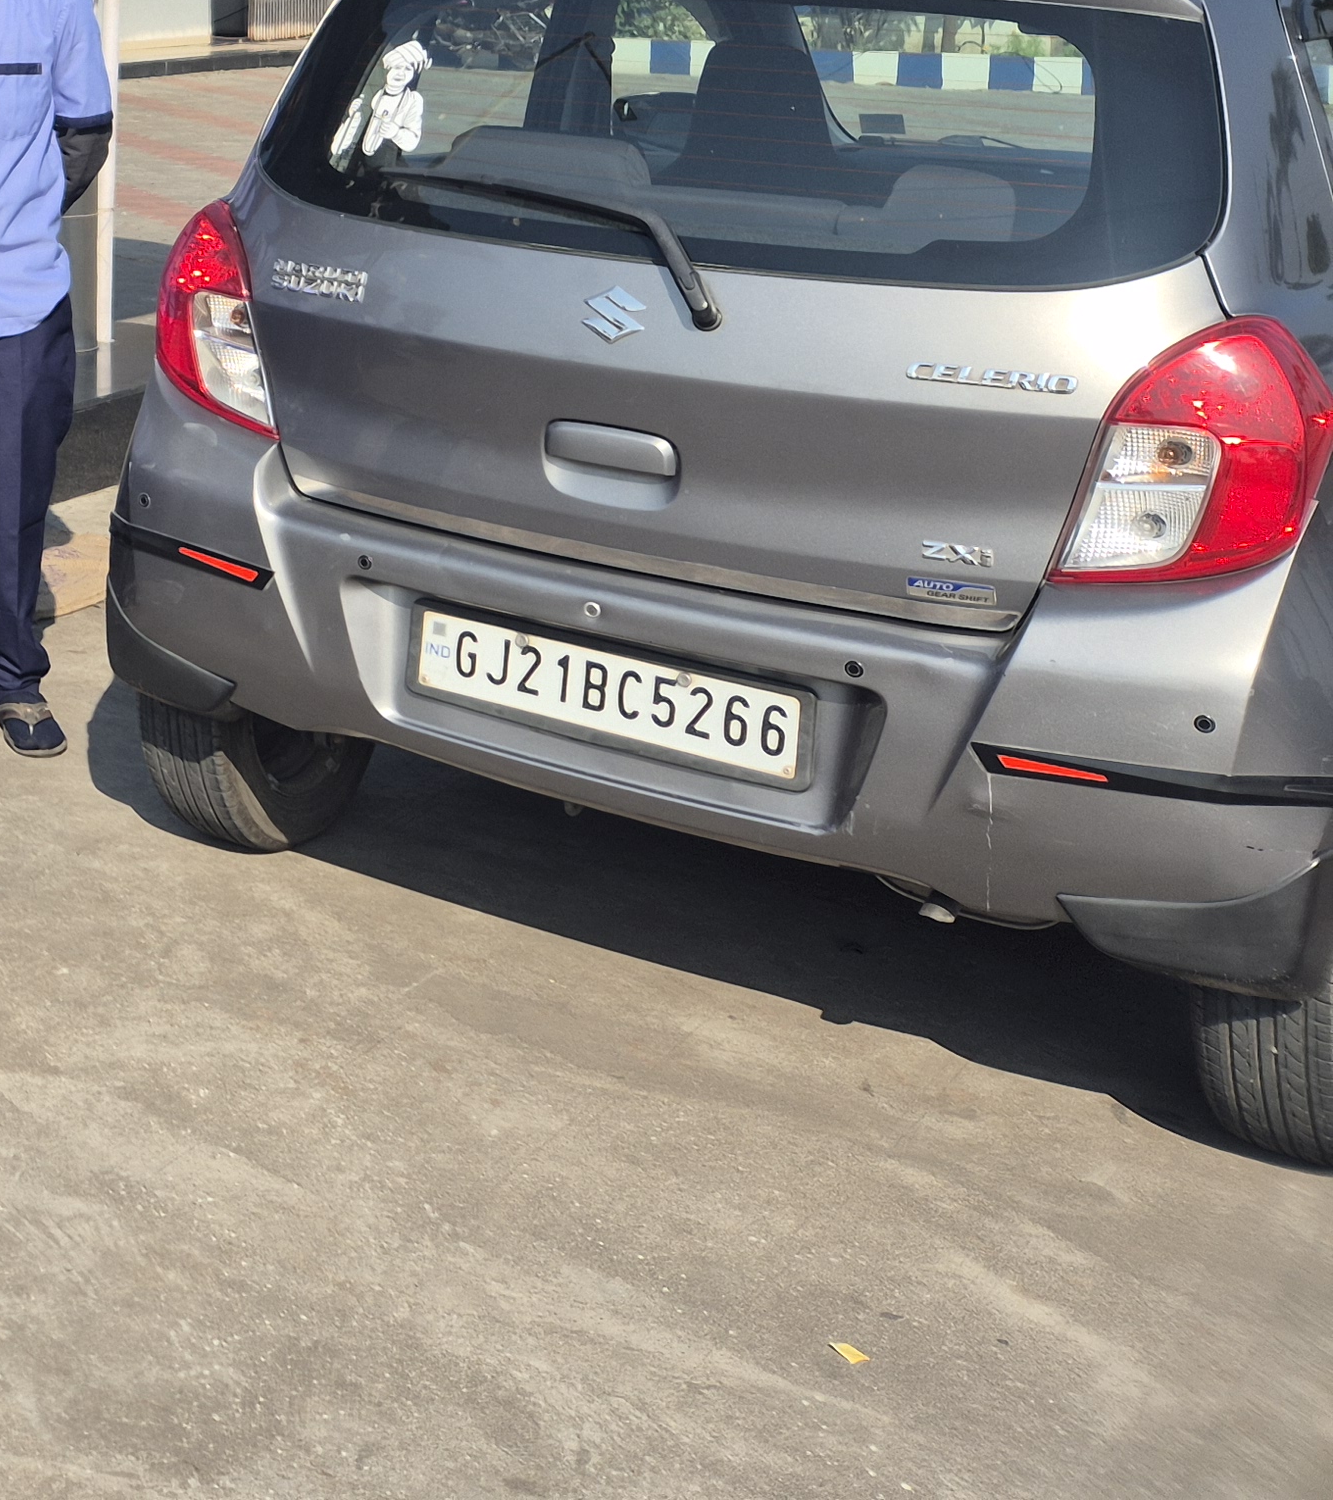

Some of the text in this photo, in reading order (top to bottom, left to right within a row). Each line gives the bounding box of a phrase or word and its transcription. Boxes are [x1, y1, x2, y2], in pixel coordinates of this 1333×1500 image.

[271, 275, 365, 303] SUZUKI
[905, 361, 1079, 395] CELERIO
[913, 580, 954, 591] AUTO
[927, 590, 989, 603] GEAR SHIFT
[424, 640, 451, 660] IND
[455, 630, 789, 757] GJ21BC5266
